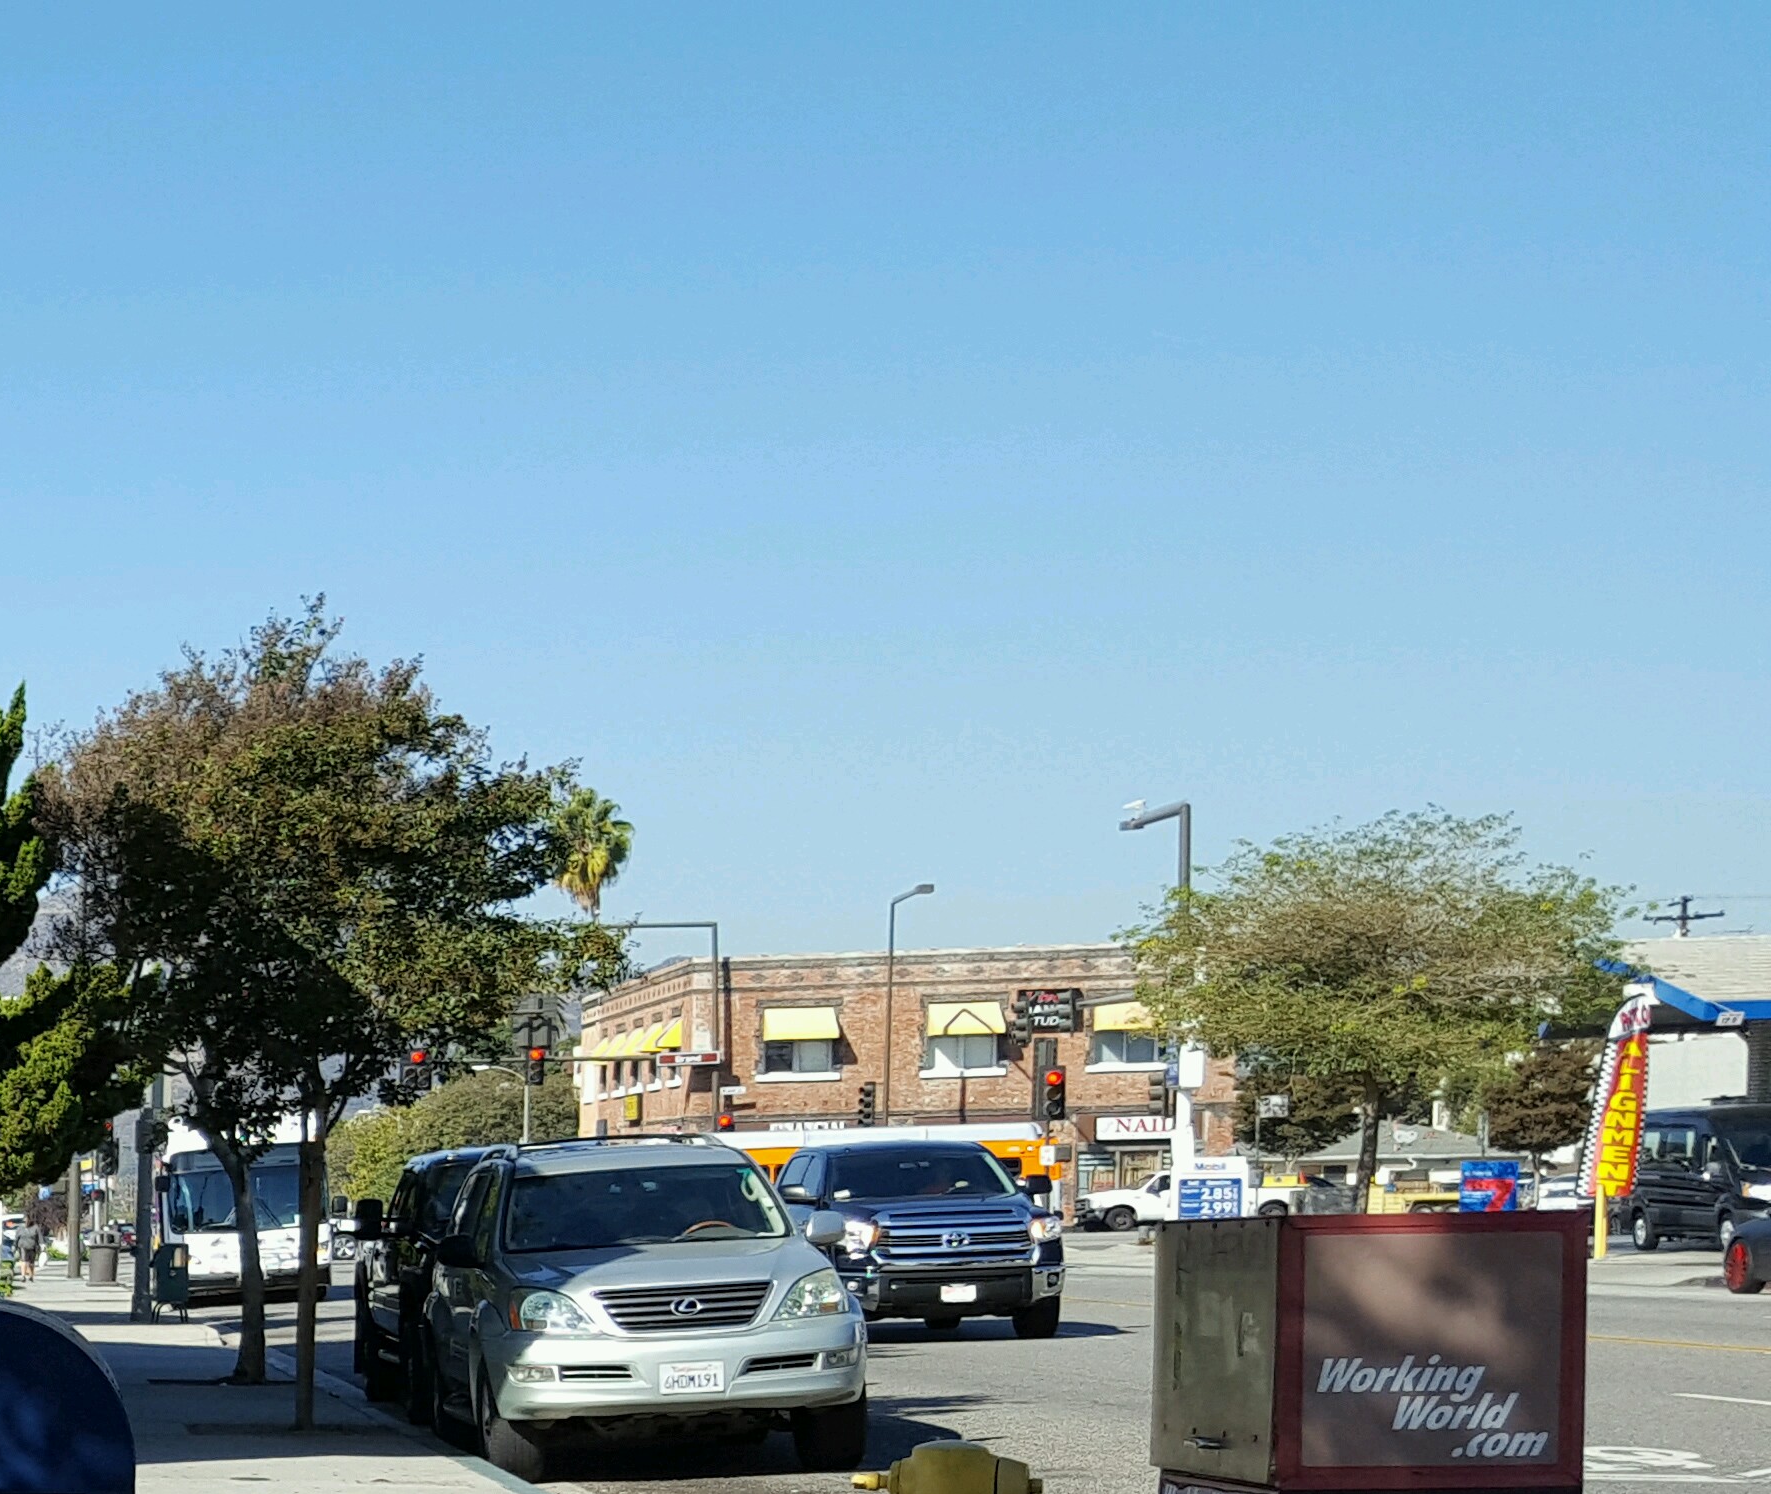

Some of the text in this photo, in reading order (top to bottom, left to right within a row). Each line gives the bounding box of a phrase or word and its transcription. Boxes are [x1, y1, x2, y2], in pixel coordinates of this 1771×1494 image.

[1596, 1040, 1643, 1198] ALIGNMENT
[1200, 1187, 1233, 1200] 2.85
[1200, 1201, 1233, 1214] 2.99
[1316, 1354, 1486, 1403] Working
[1392, 1393, 1519, 1431] World
[1451, 1431, 1548, 1458] .com
